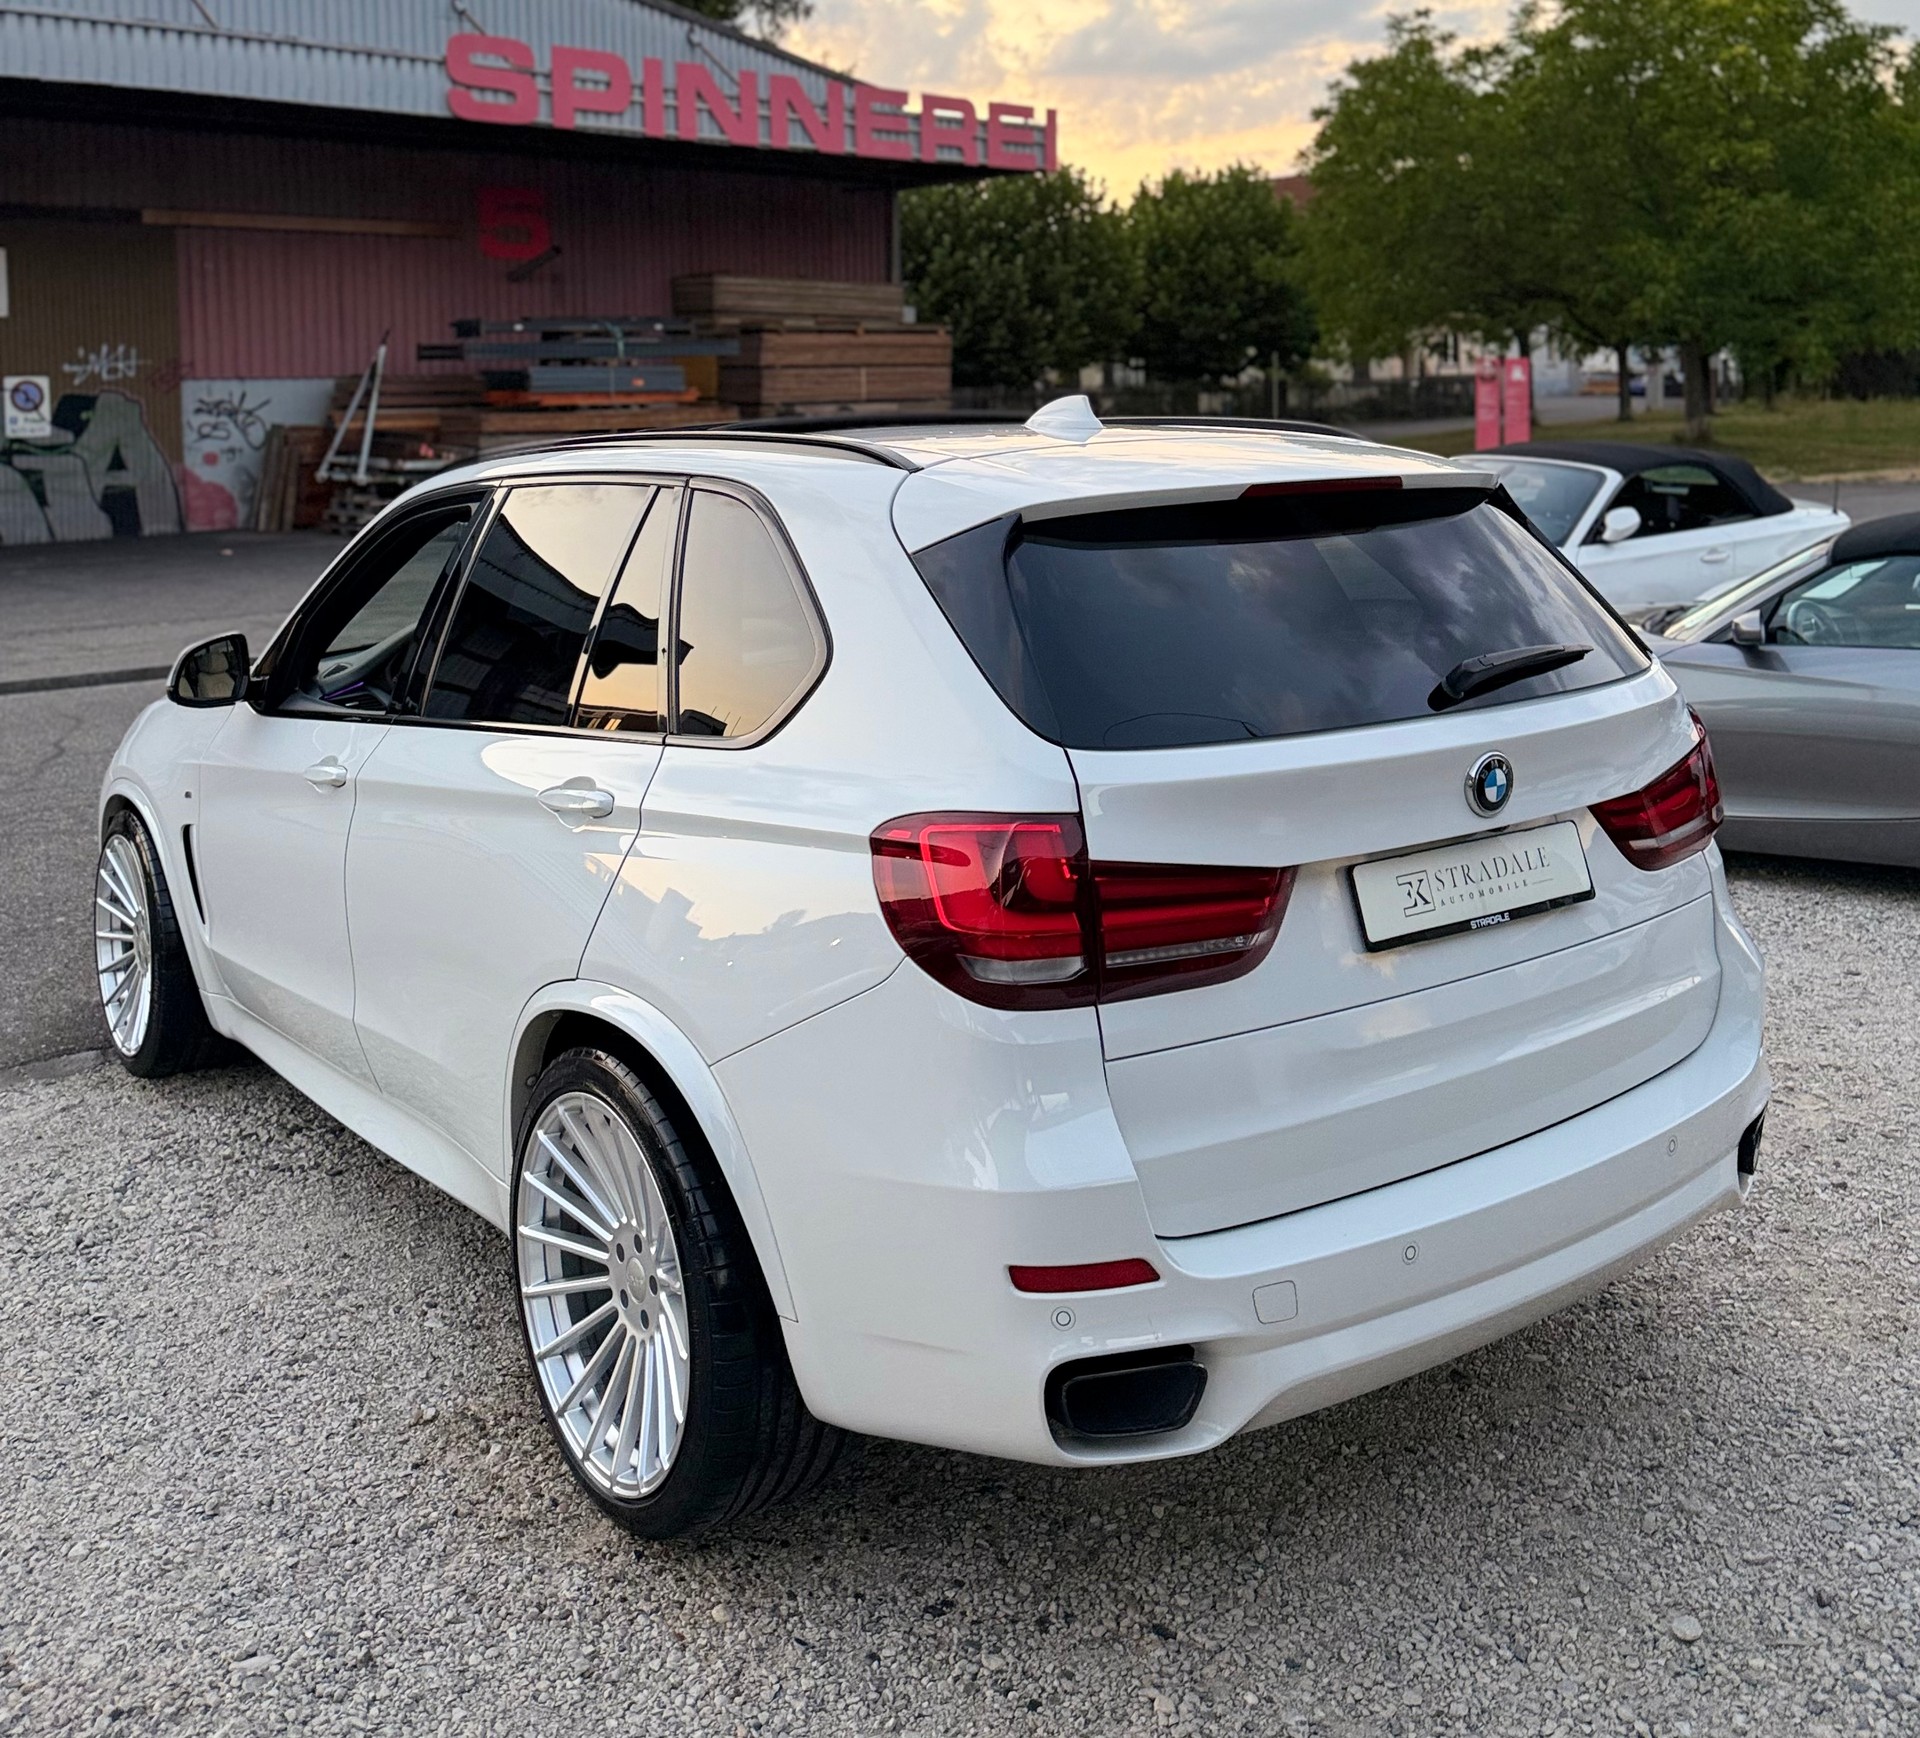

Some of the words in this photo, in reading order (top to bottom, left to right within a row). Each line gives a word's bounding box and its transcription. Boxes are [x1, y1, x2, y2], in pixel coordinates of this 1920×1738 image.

[446, 33, 1057, 171] SPINNEREI
[479, 188, 550, 260] 5
[1480, 759, 1510, 778] BMW
[1434, 847, 1550, 891] STRADALE
[1440, 879, 1528, 906] AUTOMOBILE
[1470, 912, 1510, 929] STRADALE
